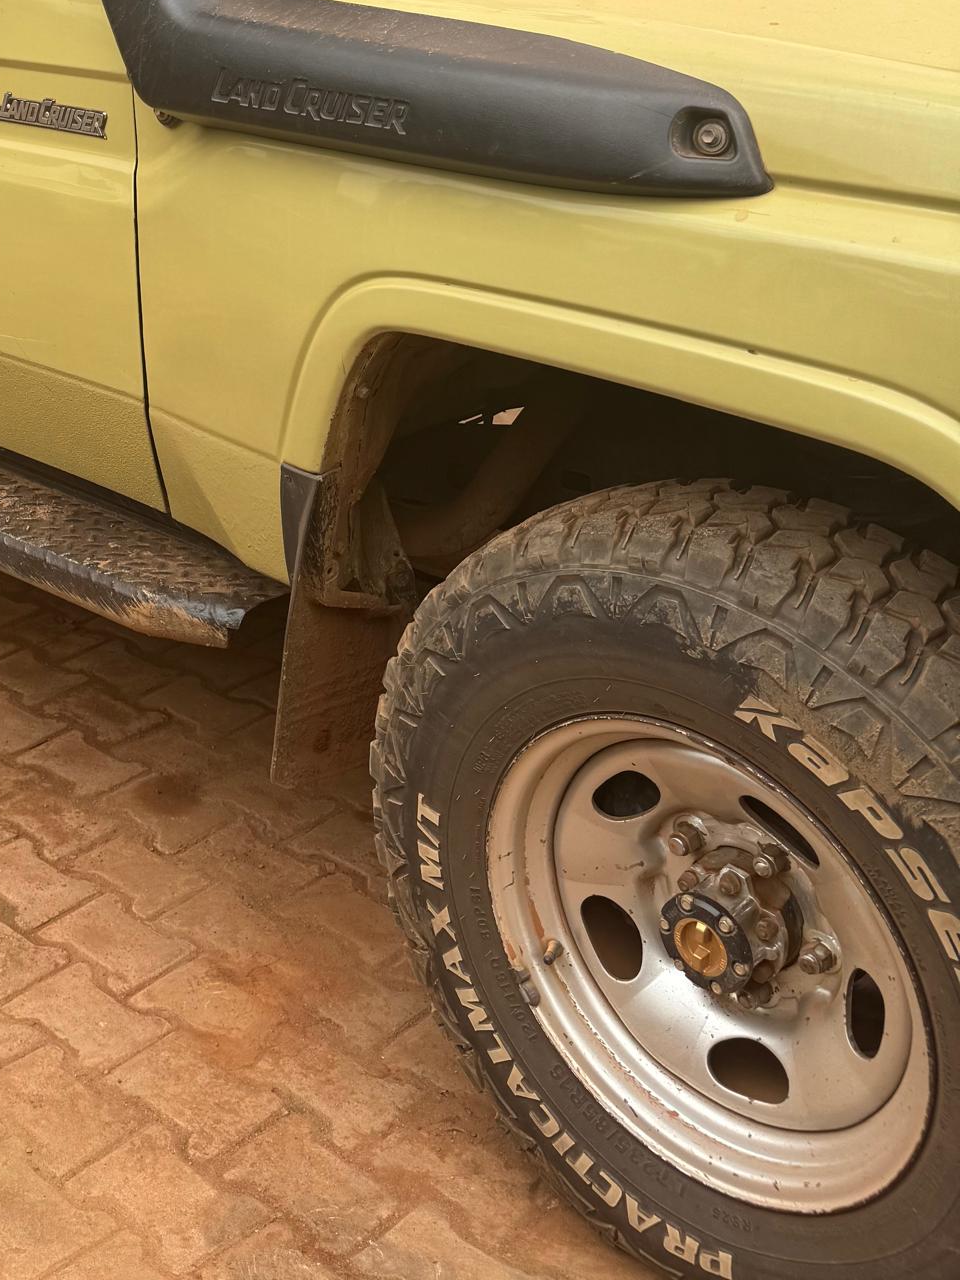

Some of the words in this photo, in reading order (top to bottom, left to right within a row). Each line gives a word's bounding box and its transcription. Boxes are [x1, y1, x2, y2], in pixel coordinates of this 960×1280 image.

[0, 91, 39, 122] LAND
[38, 98, 107, 138] CRUISER
[211, 66, 283, 111] LAND
[283, 77, 410, 136] CRUISER
[416, 792, 445, 891] M/T
[426, 898, 734, 1280] PRACTICALMAX
